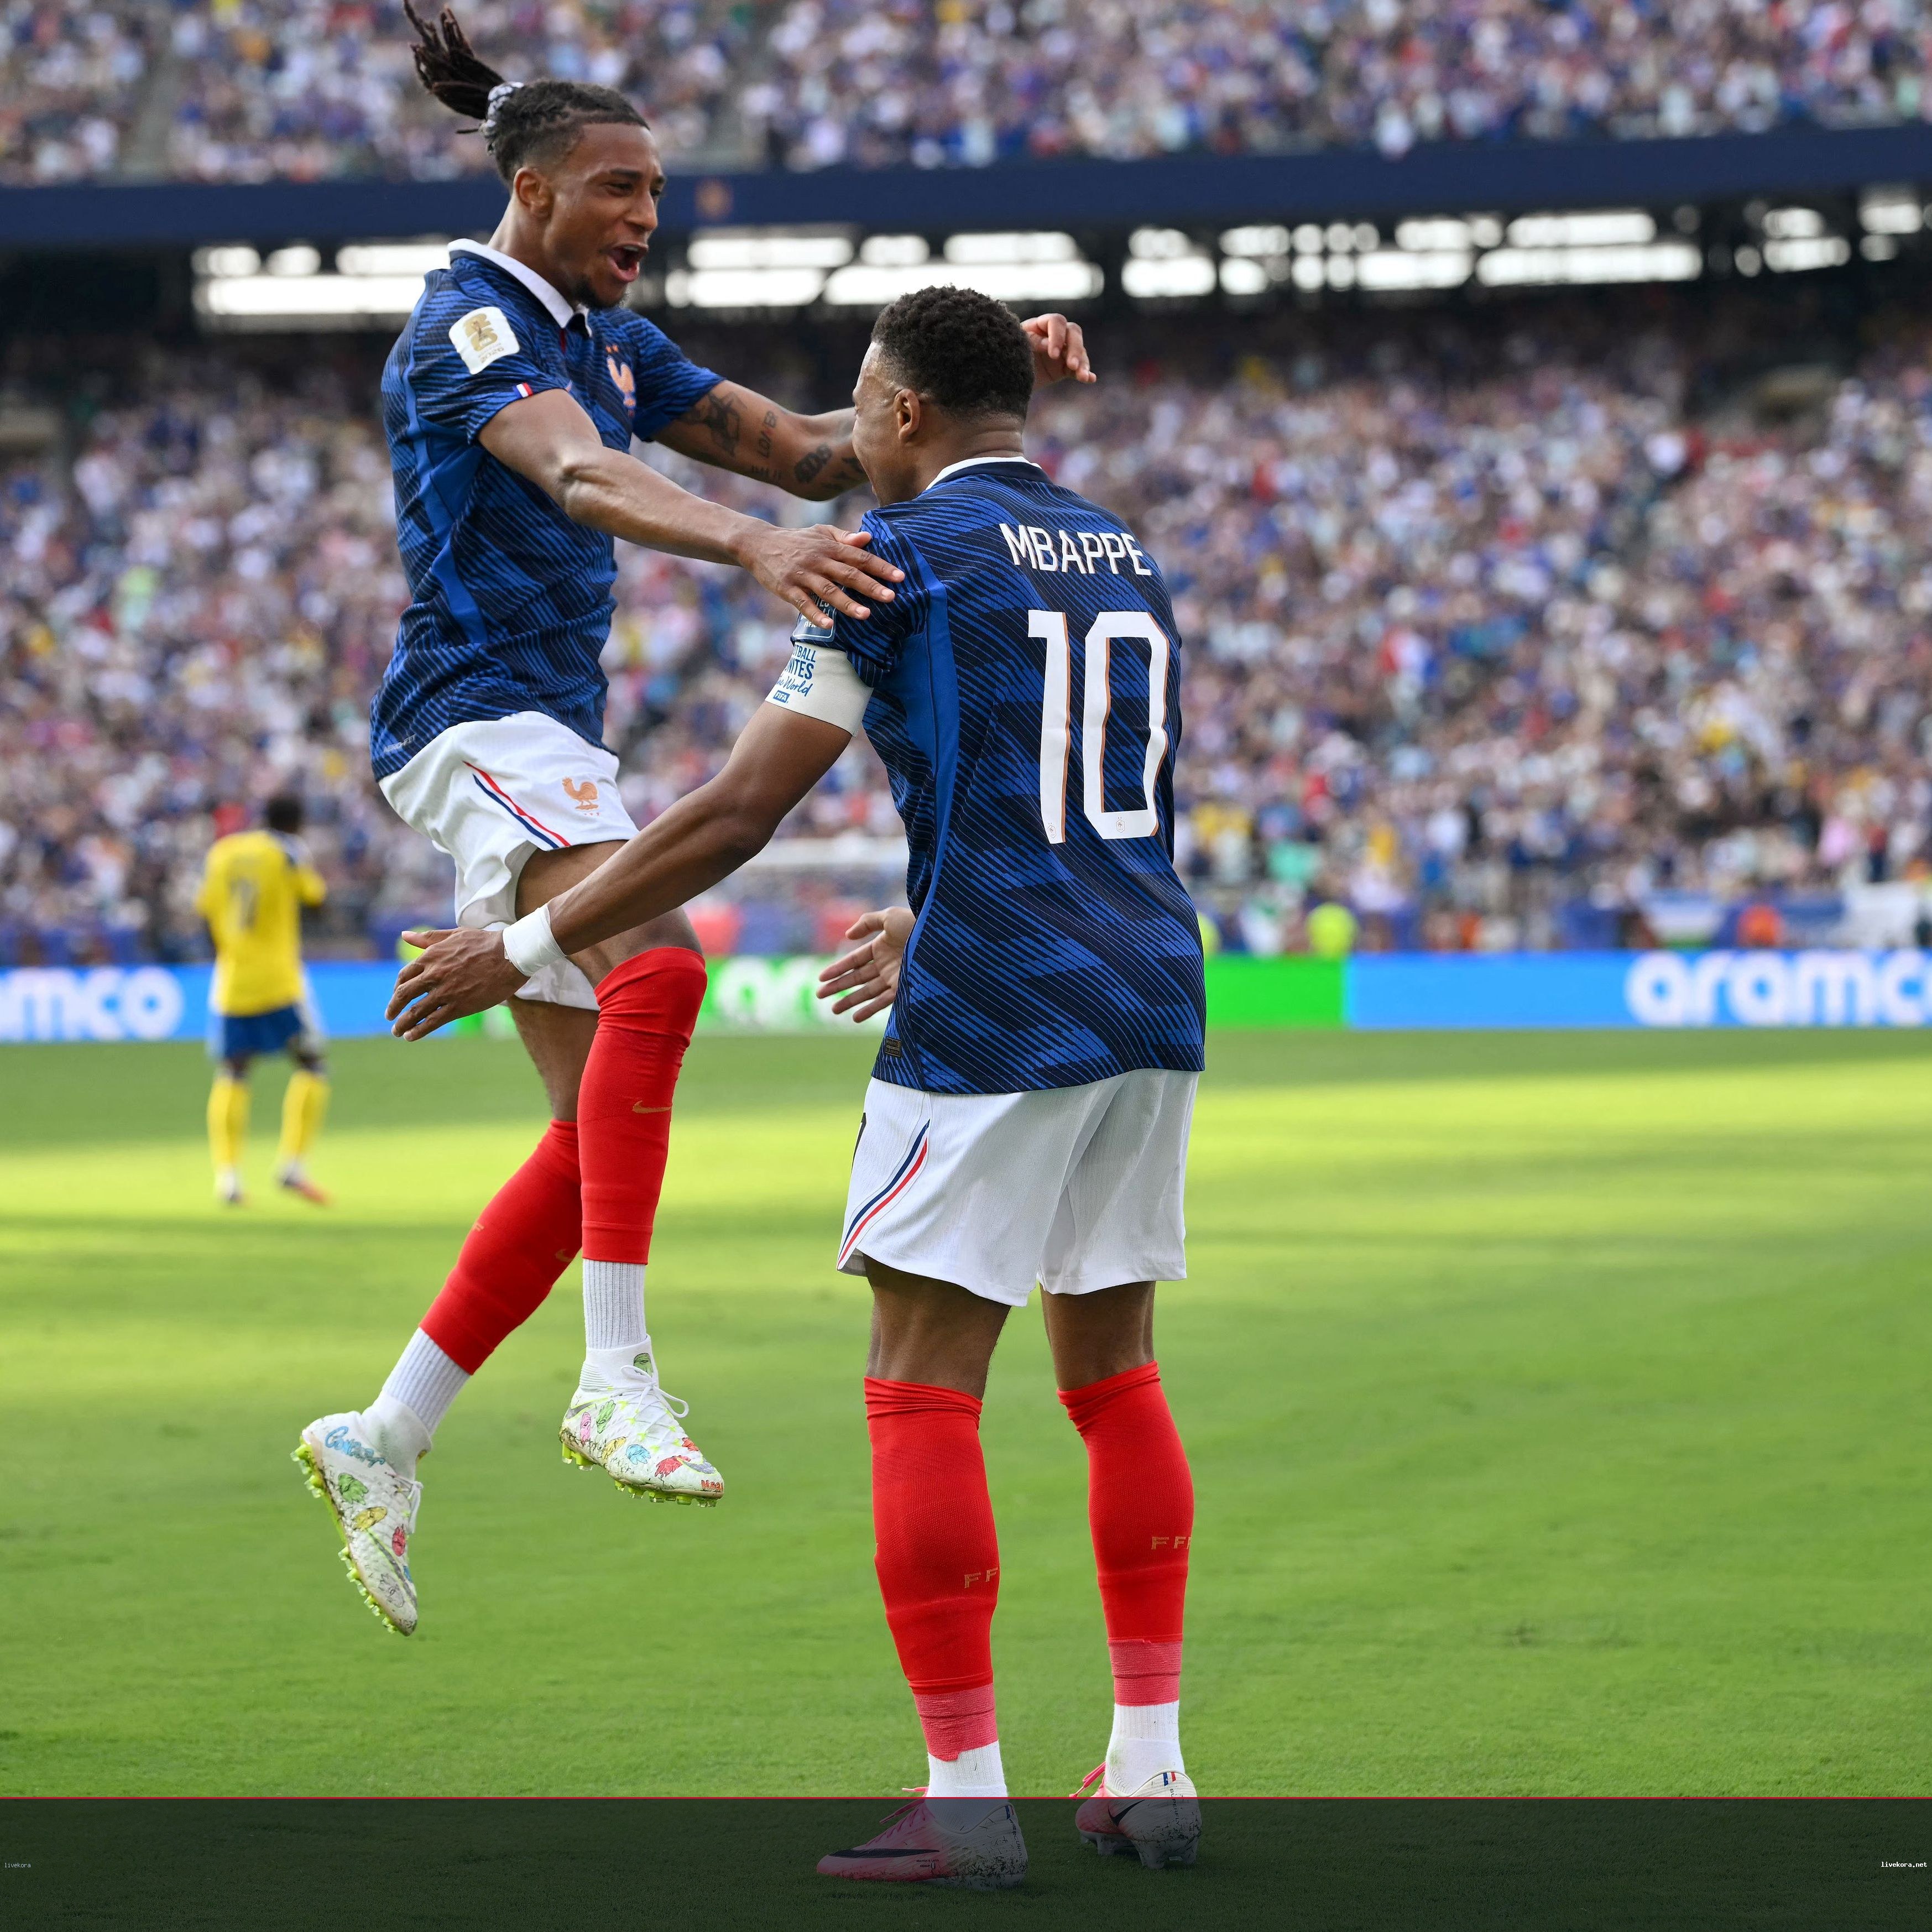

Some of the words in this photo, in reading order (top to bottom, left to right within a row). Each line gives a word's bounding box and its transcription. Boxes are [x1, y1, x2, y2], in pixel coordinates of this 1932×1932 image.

[999, 523, 1152, 576] MBAPPE
[785, 657, 814, 680] NITES
[793, 644, 816, 663] TBALL
[783, 676, 813, 697] World
[1028, 610, 1170, 844] 10
[1626, 952, 1932, 1026] aramc
